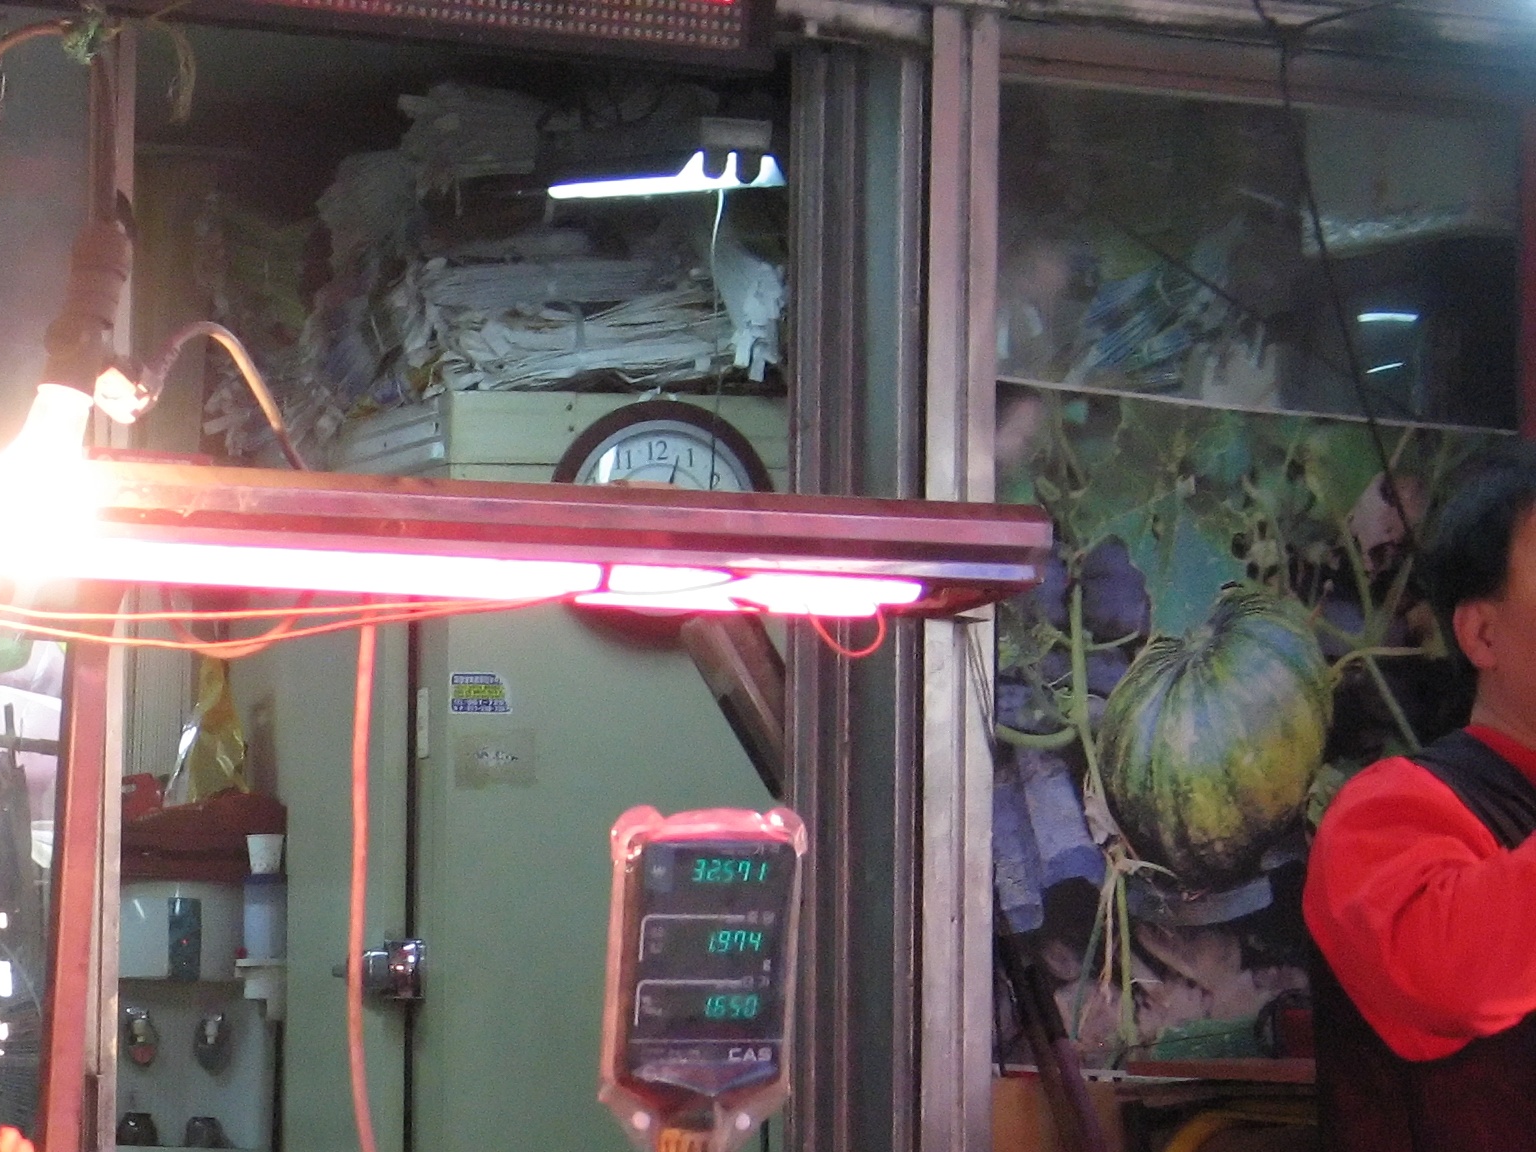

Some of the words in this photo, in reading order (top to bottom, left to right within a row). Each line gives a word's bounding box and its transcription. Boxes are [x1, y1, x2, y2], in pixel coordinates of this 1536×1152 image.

[615, 445, 632, 470] 11
[647, 440, 668, 461] 12
[687, 447, 694, 468] 1
[691, 857, 768, 883] 32571
[728, 1046, 773, 1062] CAS
